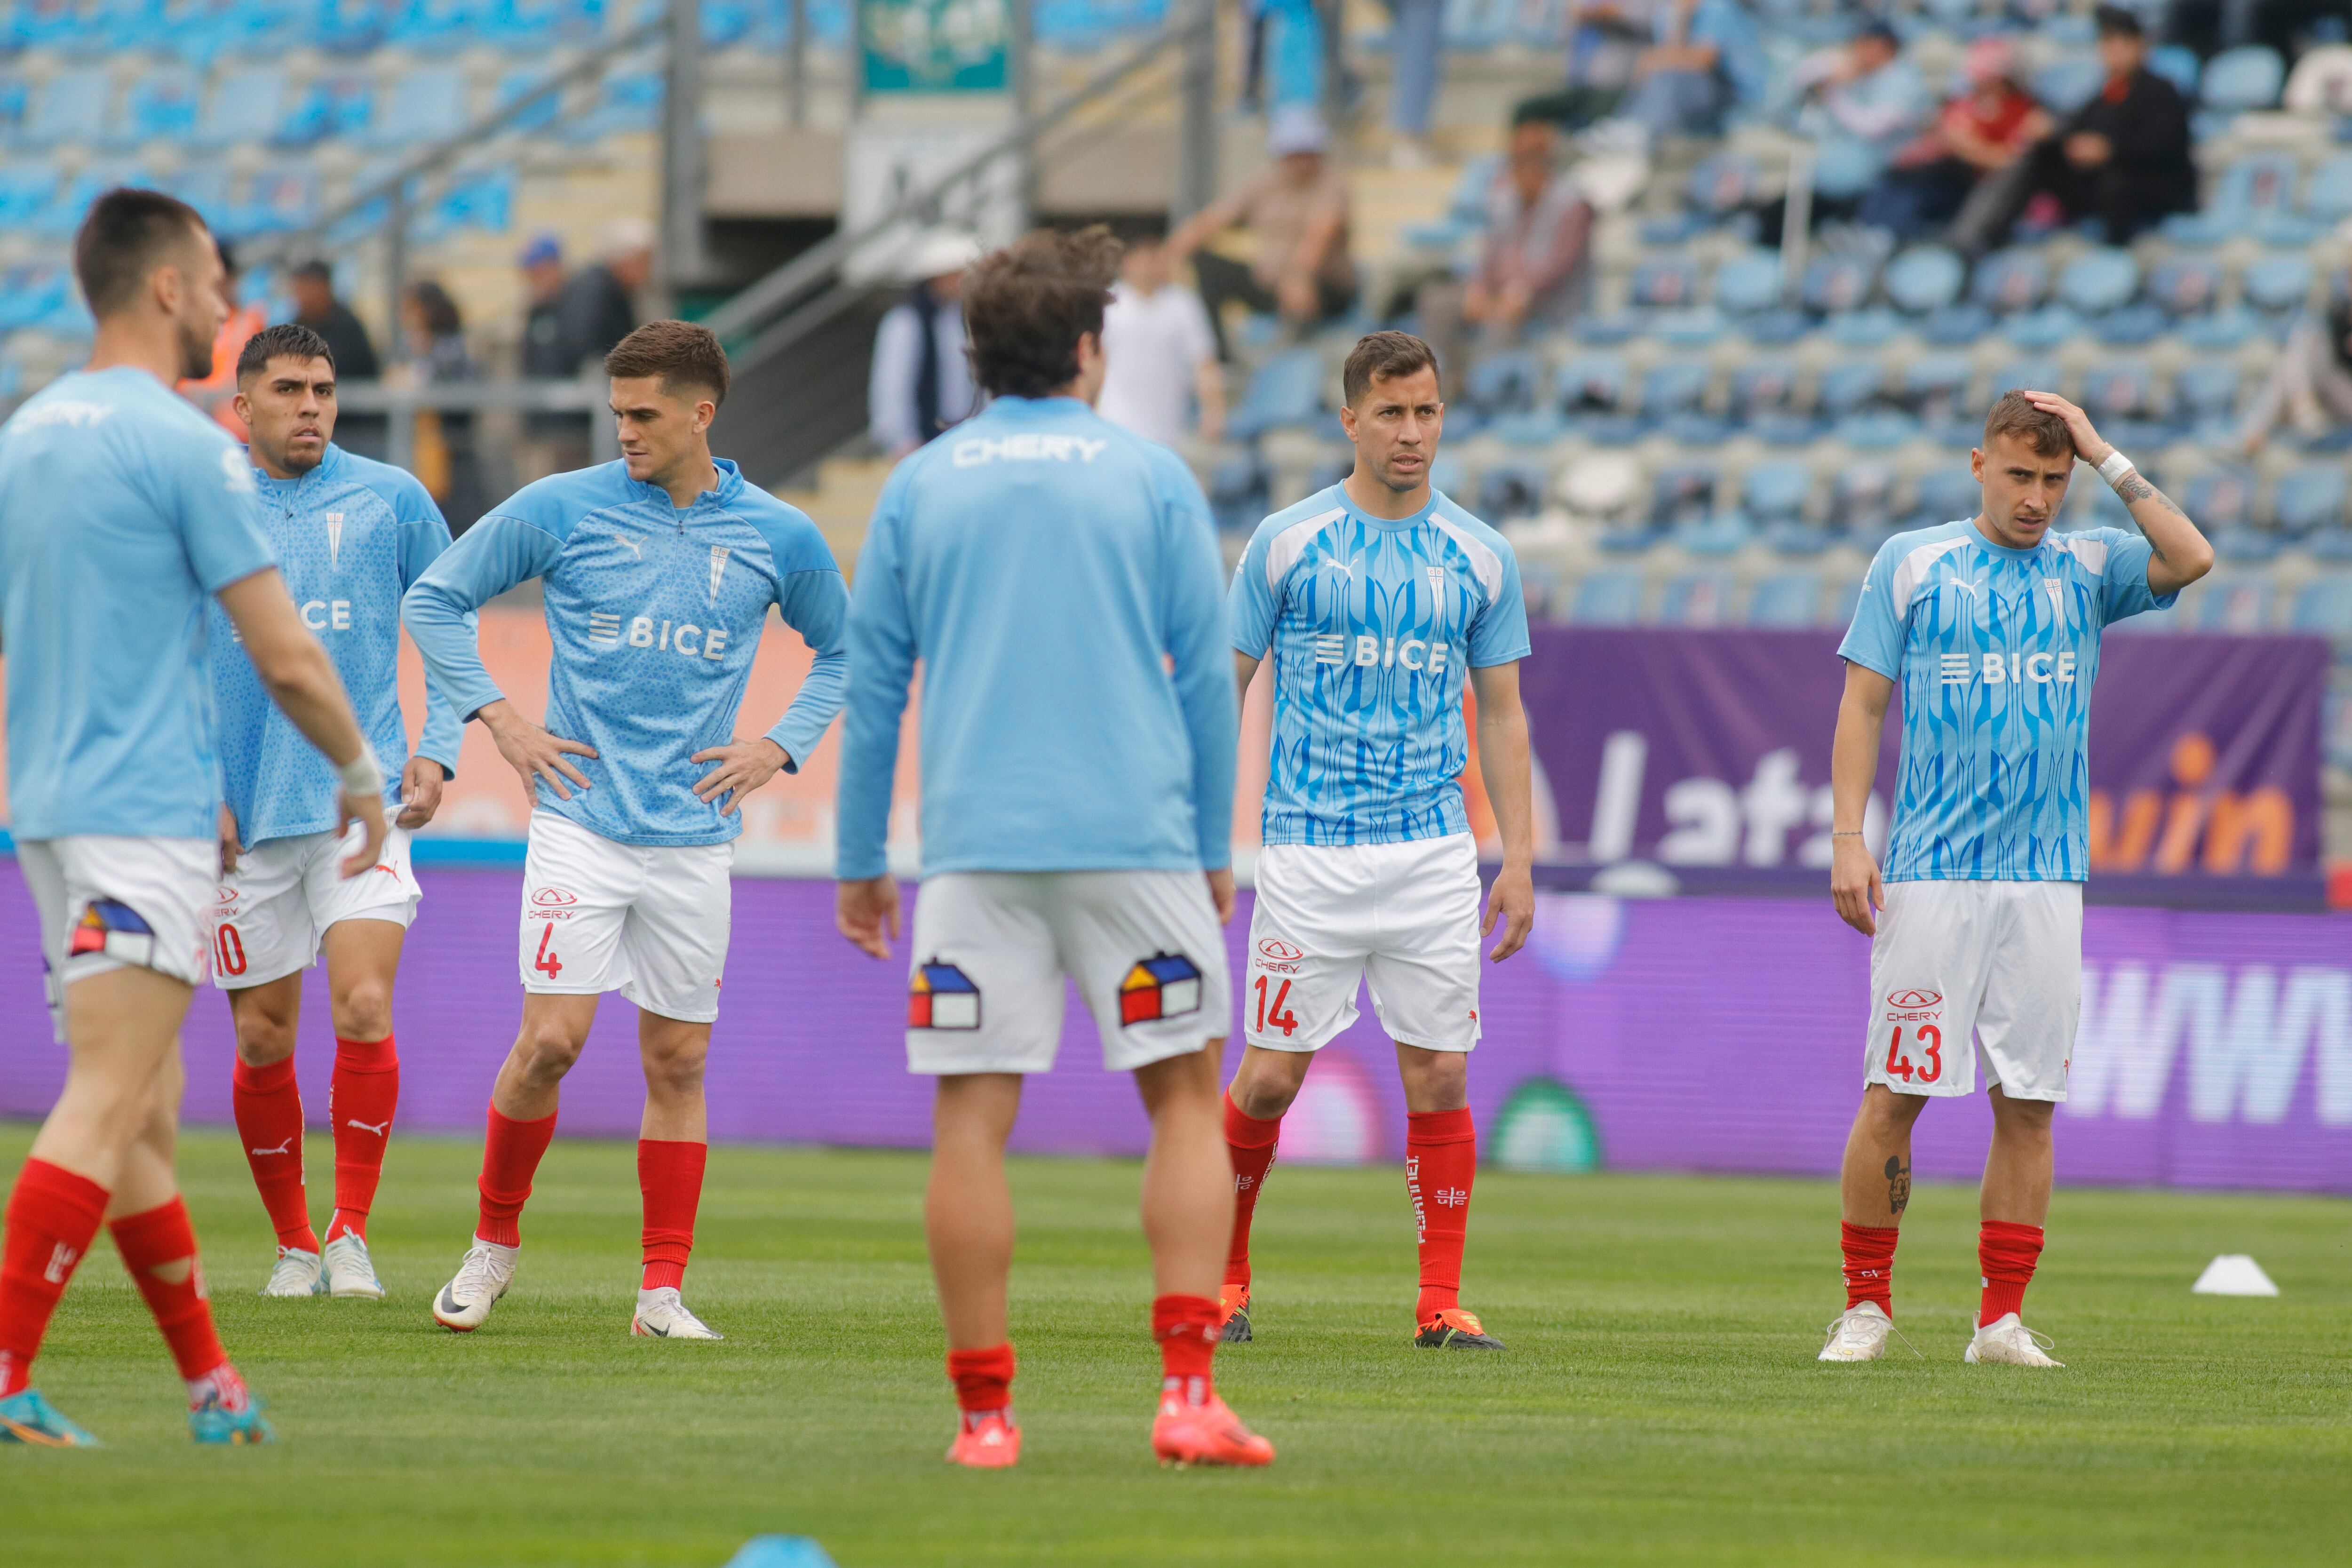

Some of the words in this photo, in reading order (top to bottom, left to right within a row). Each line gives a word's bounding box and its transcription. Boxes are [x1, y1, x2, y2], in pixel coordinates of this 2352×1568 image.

[290, 600, 350, 630] CE
[629, 617, 727, 661] BICE
[1355, 636, 1448, 673] BICE
[1983, 652, 2075, 684] BICE
[528, 910, 575, 919] CHERY
[535, 922, 563, 980] 4
[1255, 958, 1301, 973] CHERY
[1255, 975, 1298, 1037] 14
[1887, 1011, 1943, 1021] CHERY
[1885, 1024, 1941, 1082] 43
